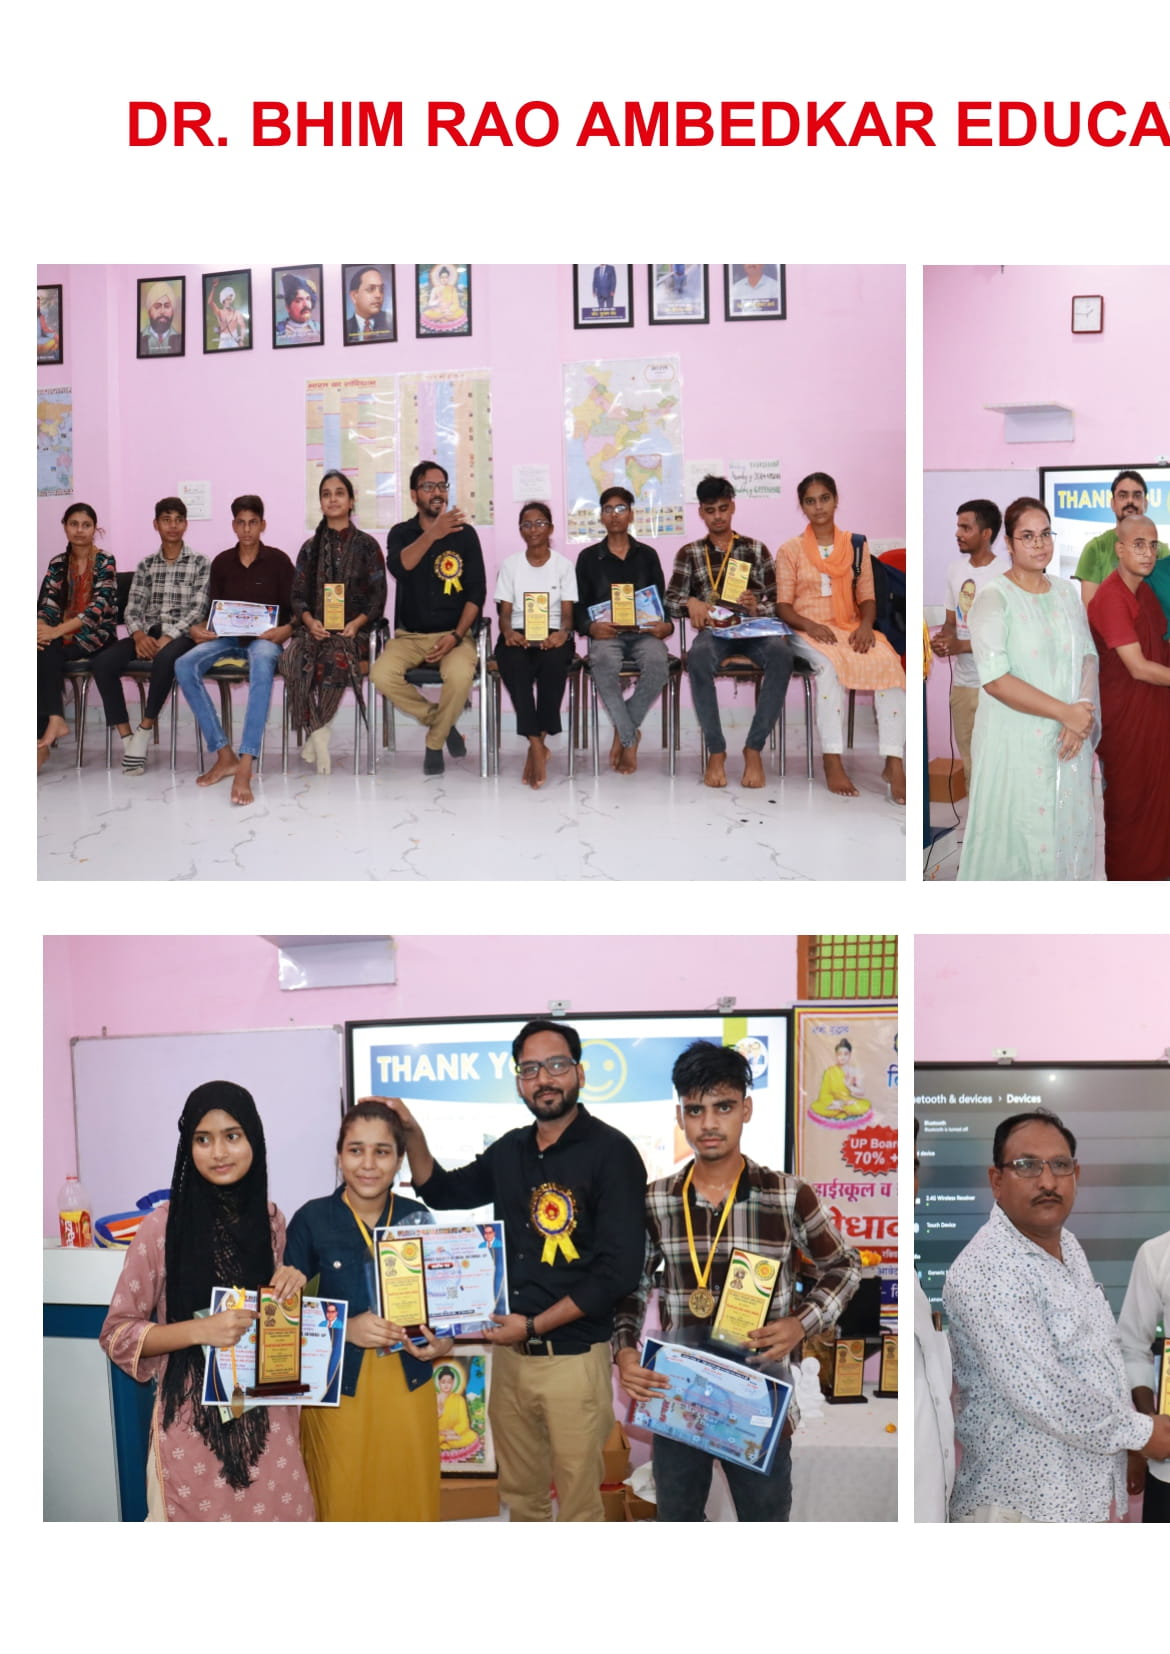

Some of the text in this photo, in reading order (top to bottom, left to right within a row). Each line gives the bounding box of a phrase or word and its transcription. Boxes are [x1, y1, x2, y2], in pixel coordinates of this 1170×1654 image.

[376, 1052, 481, 1083] THANK
[914, 1094, 946, 1104] etooth
[958, 1094, 992, 1104] devices
[1006, 1094, 1041, 1104] Devices
[850, 1138, 898, 1149] UP Boar
[854, 1151, 885, 1165] 70%
[880, 1183, 893, 1197] व
